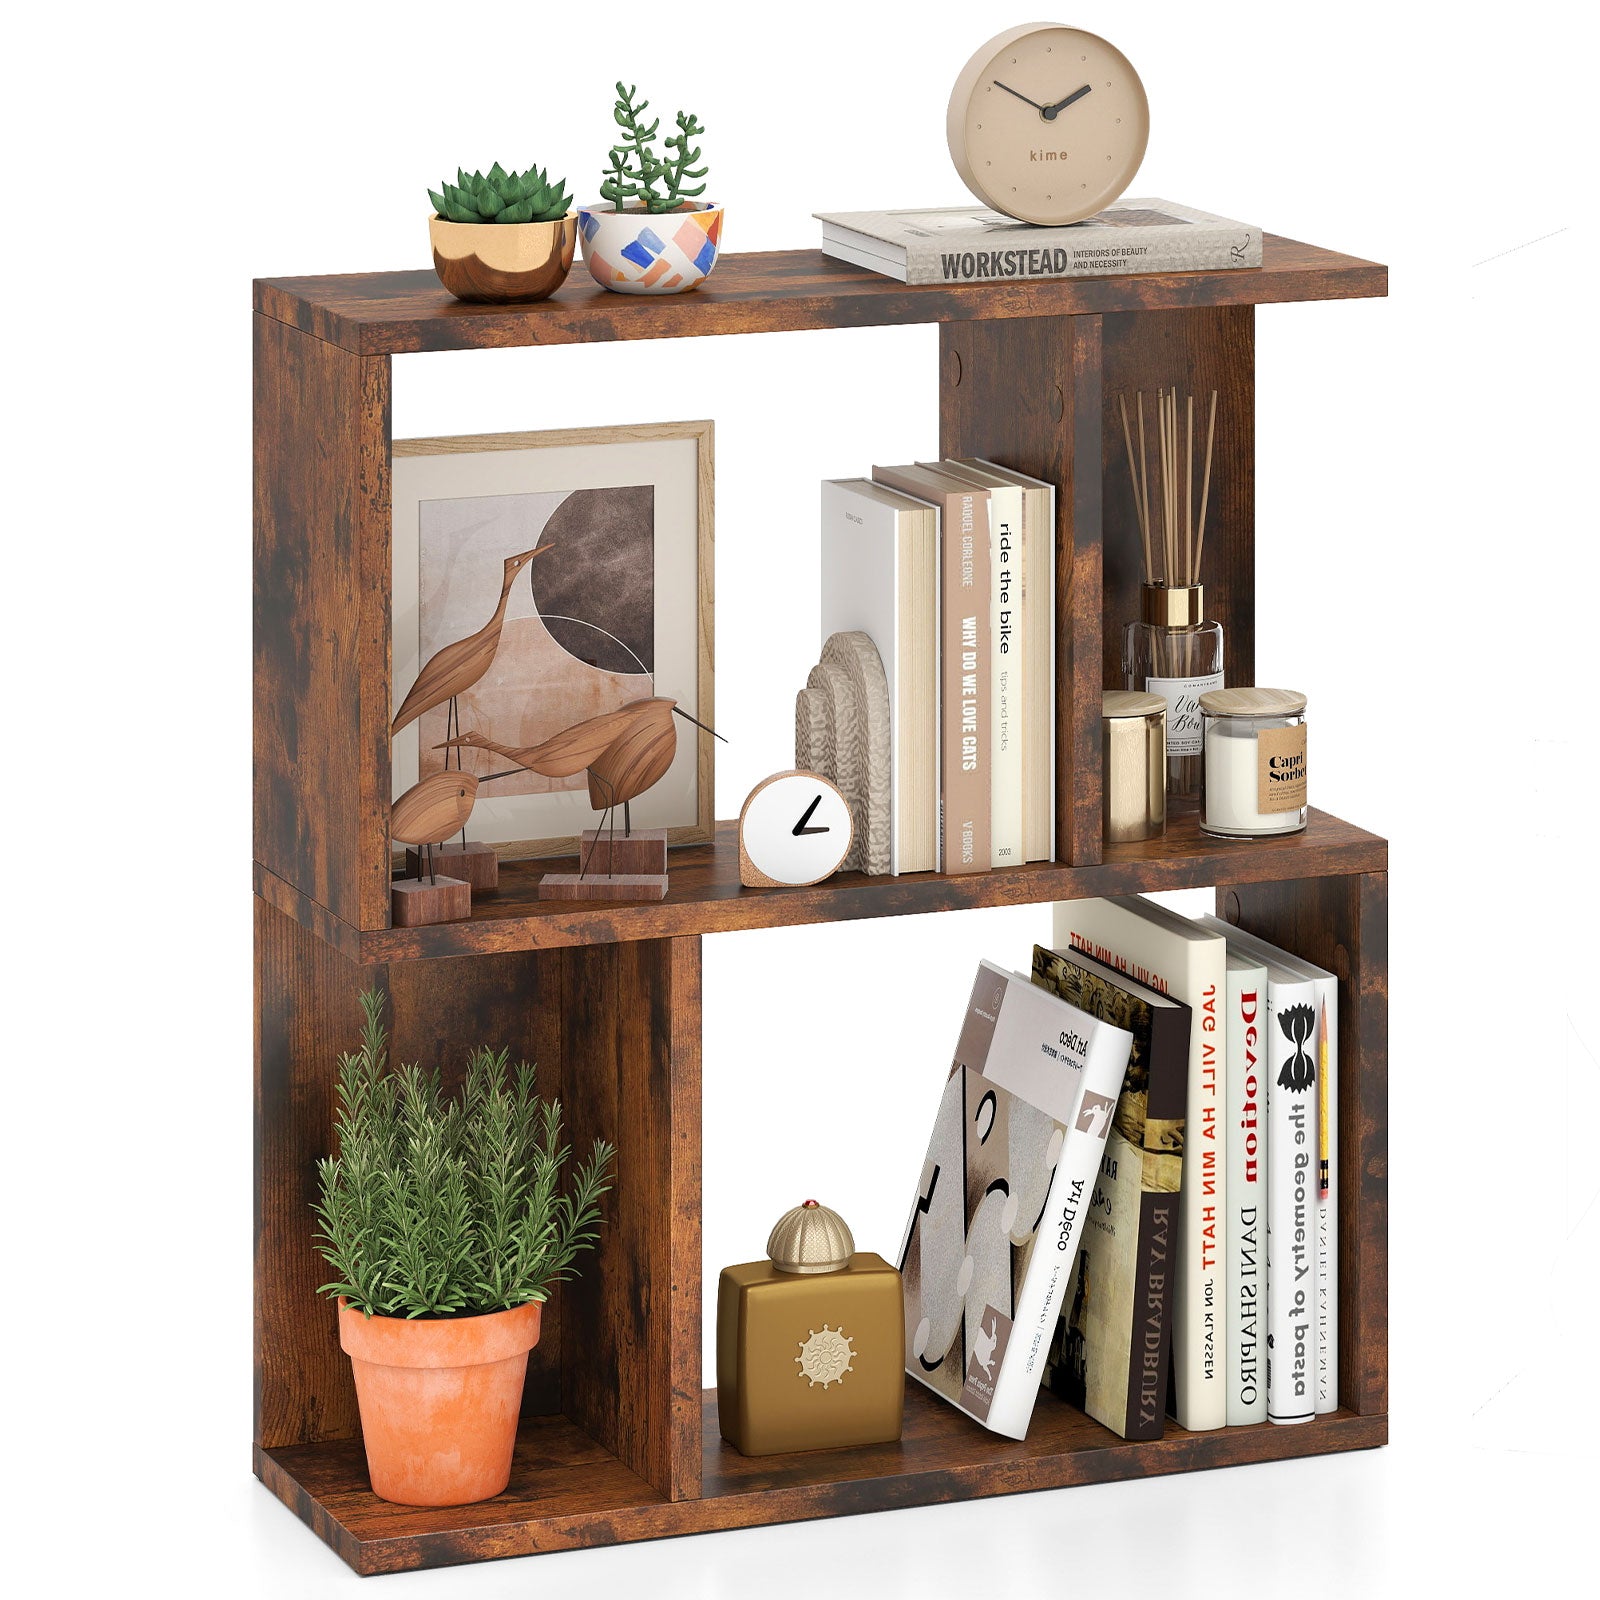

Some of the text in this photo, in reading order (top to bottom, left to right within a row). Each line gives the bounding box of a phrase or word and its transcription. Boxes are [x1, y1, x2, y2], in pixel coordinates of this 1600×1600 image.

[1030, 150, 1068, 162] kime
[941, 248, 1068, 280] WORKSTEAD
[1073, 247, 1148, 258] INTERIORS OF BEAUTY
[1073, 259, 1127, 270] AND NECESSITY
[962, 496, 973, 587] RAQUEL CORLEONE
[1000, 523, 1012, 654] ride the bike
[962, 616, 977, 771] WHY DO WE LOVE CATS
[1000, 671, 1009, 752] tips and tricks
[1269, 751, 1303, 769] Capri
[998, 847, 1011, 857] 2003
